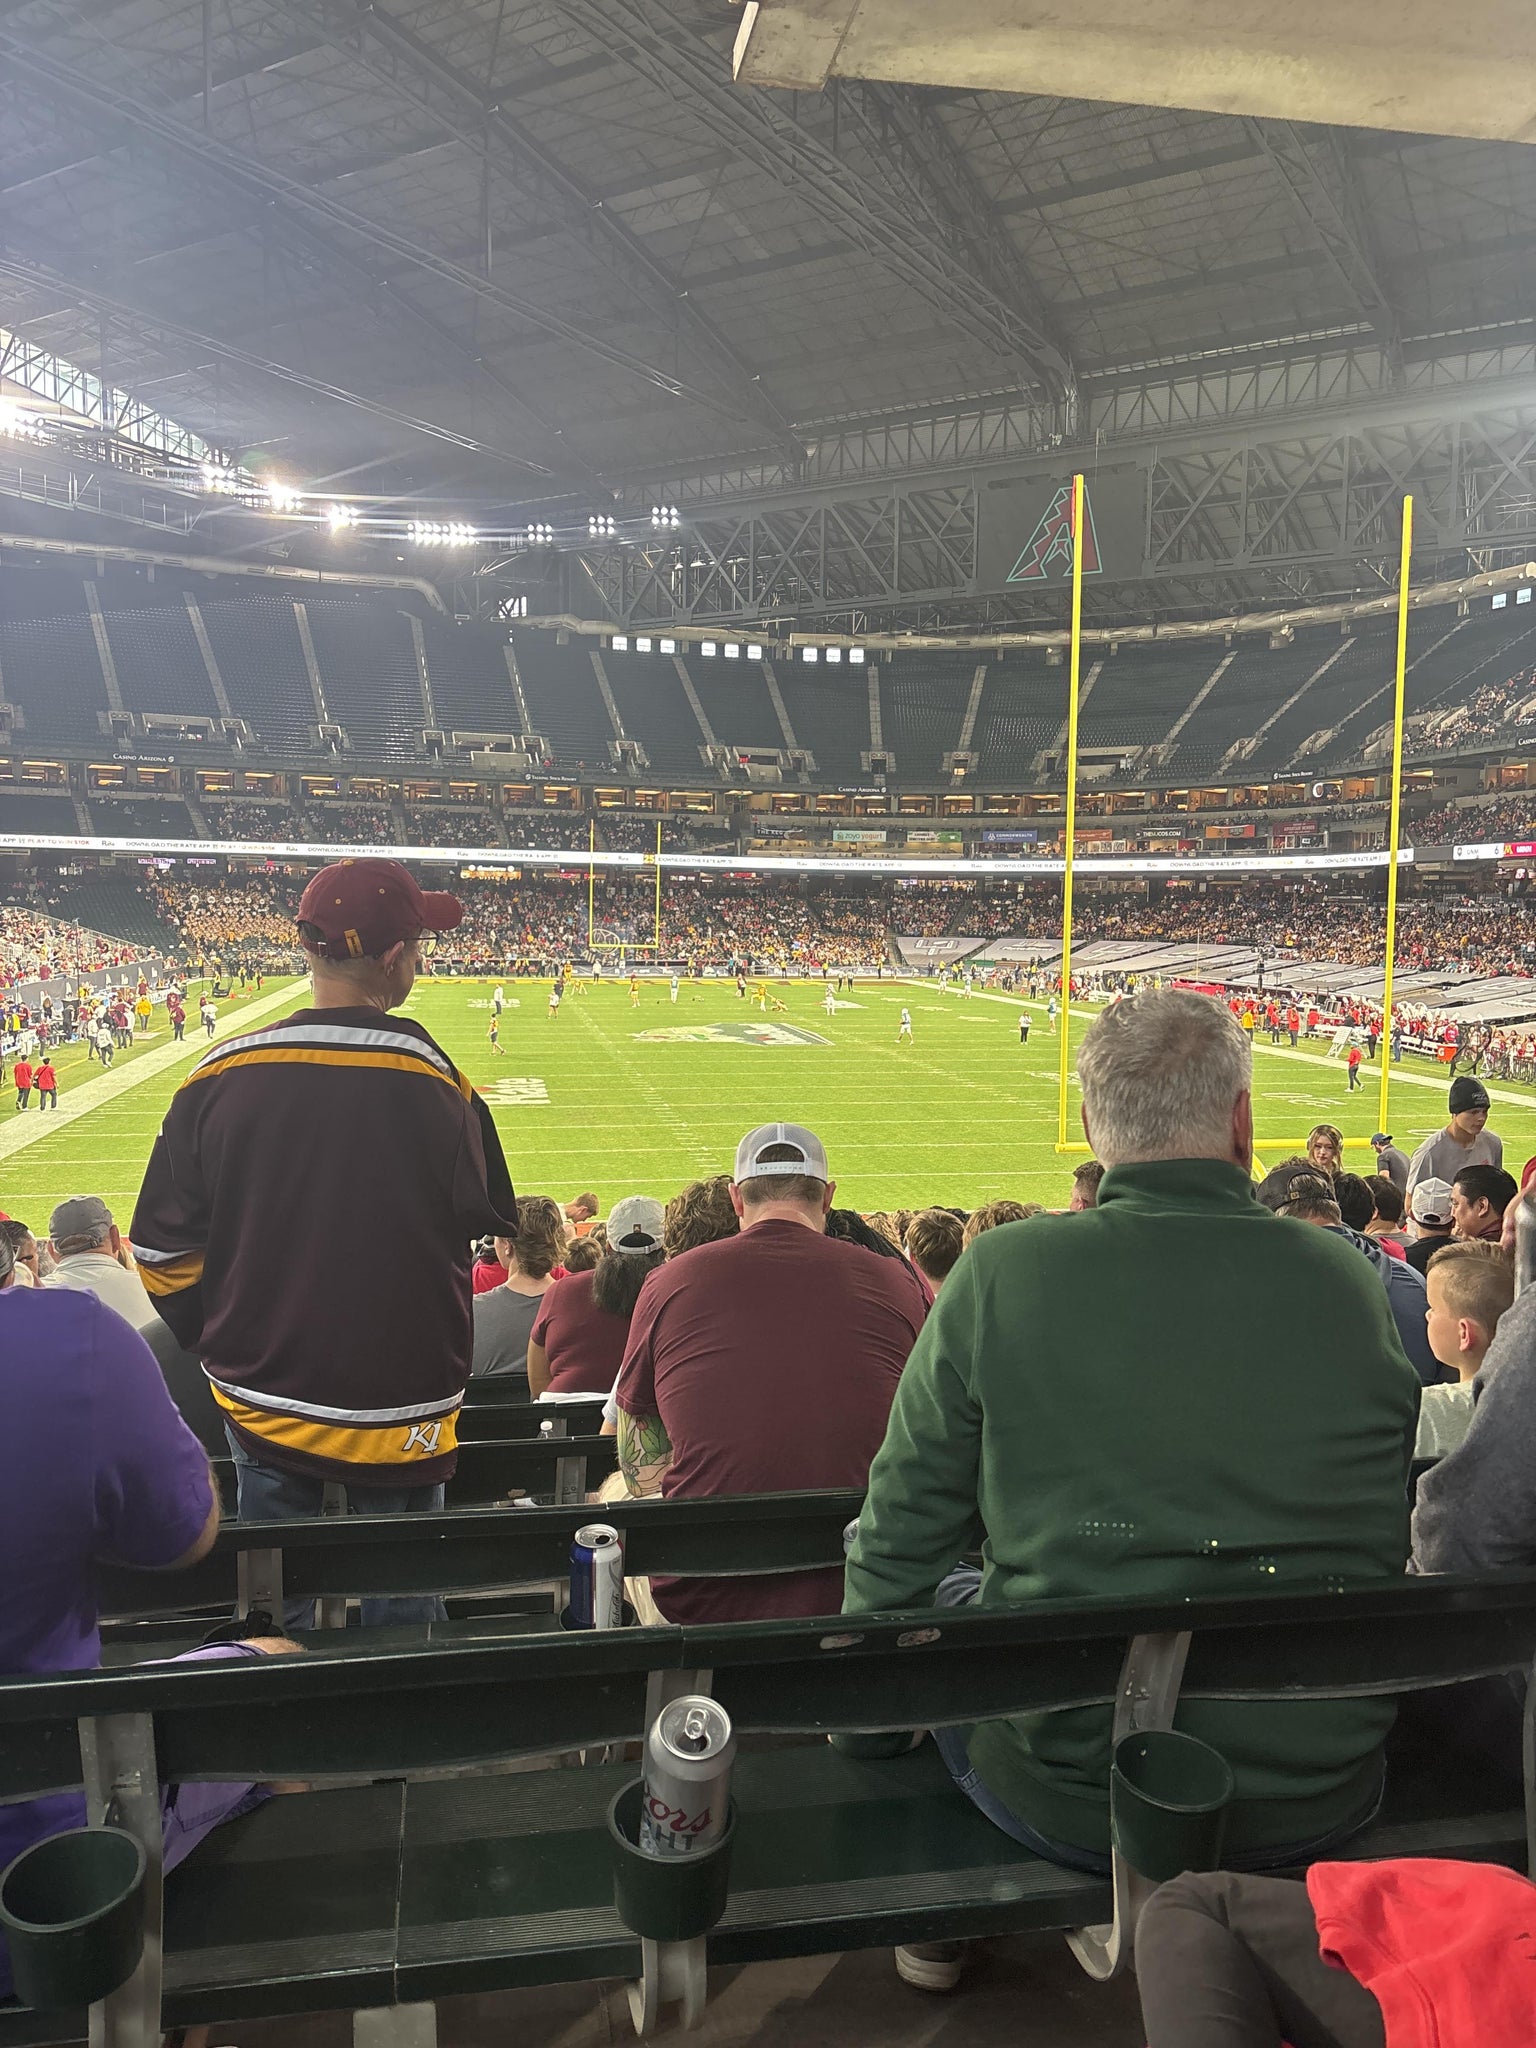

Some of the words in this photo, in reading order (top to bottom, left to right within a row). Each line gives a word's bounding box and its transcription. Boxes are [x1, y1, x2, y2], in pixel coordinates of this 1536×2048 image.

[138, 754, 166, 762] ARIZONA
[845, 832, 860, 841] zoyo
[861, 832, 883, 841] yogurt
[1515, 845, 1534, 854] MINN
